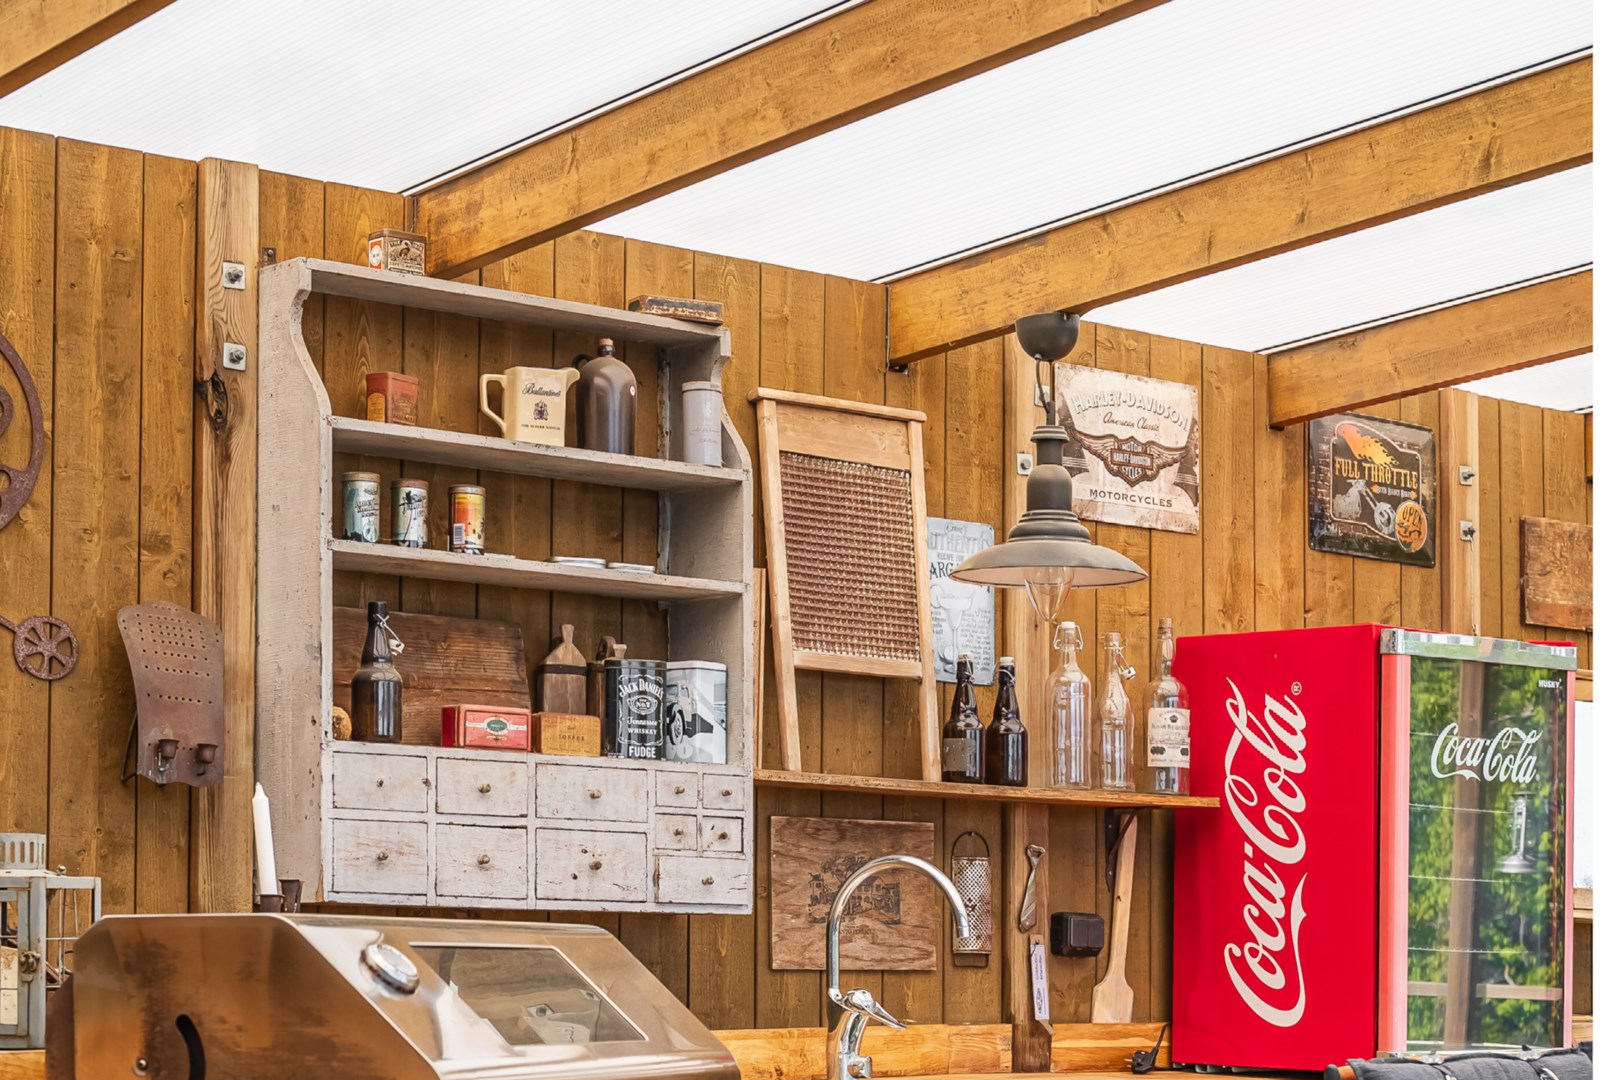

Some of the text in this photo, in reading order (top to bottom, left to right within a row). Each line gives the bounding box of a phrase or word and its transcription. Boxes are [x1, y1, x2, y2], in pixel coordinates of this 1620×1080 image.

[1070, 390, 1188, 432] HARLEY-DAVIDSON
[1103, 411, 1160, 432] American Classic
[1334, 456, 1418, 490] FULL THROTTLE
[1089, 488, 1173, 508] MOTORCYCLES
[1402, 505, 1422, 528] OPEN
[619, 682, 639, 698] JACK
[1538, 679, 1560, 688] HUSKY
[629, 745, 657, 758] FUDGE
[1430, 722, 1544, 784] Coca-Cola
[1224, 676, 1308, 1028] Coca-Cola
